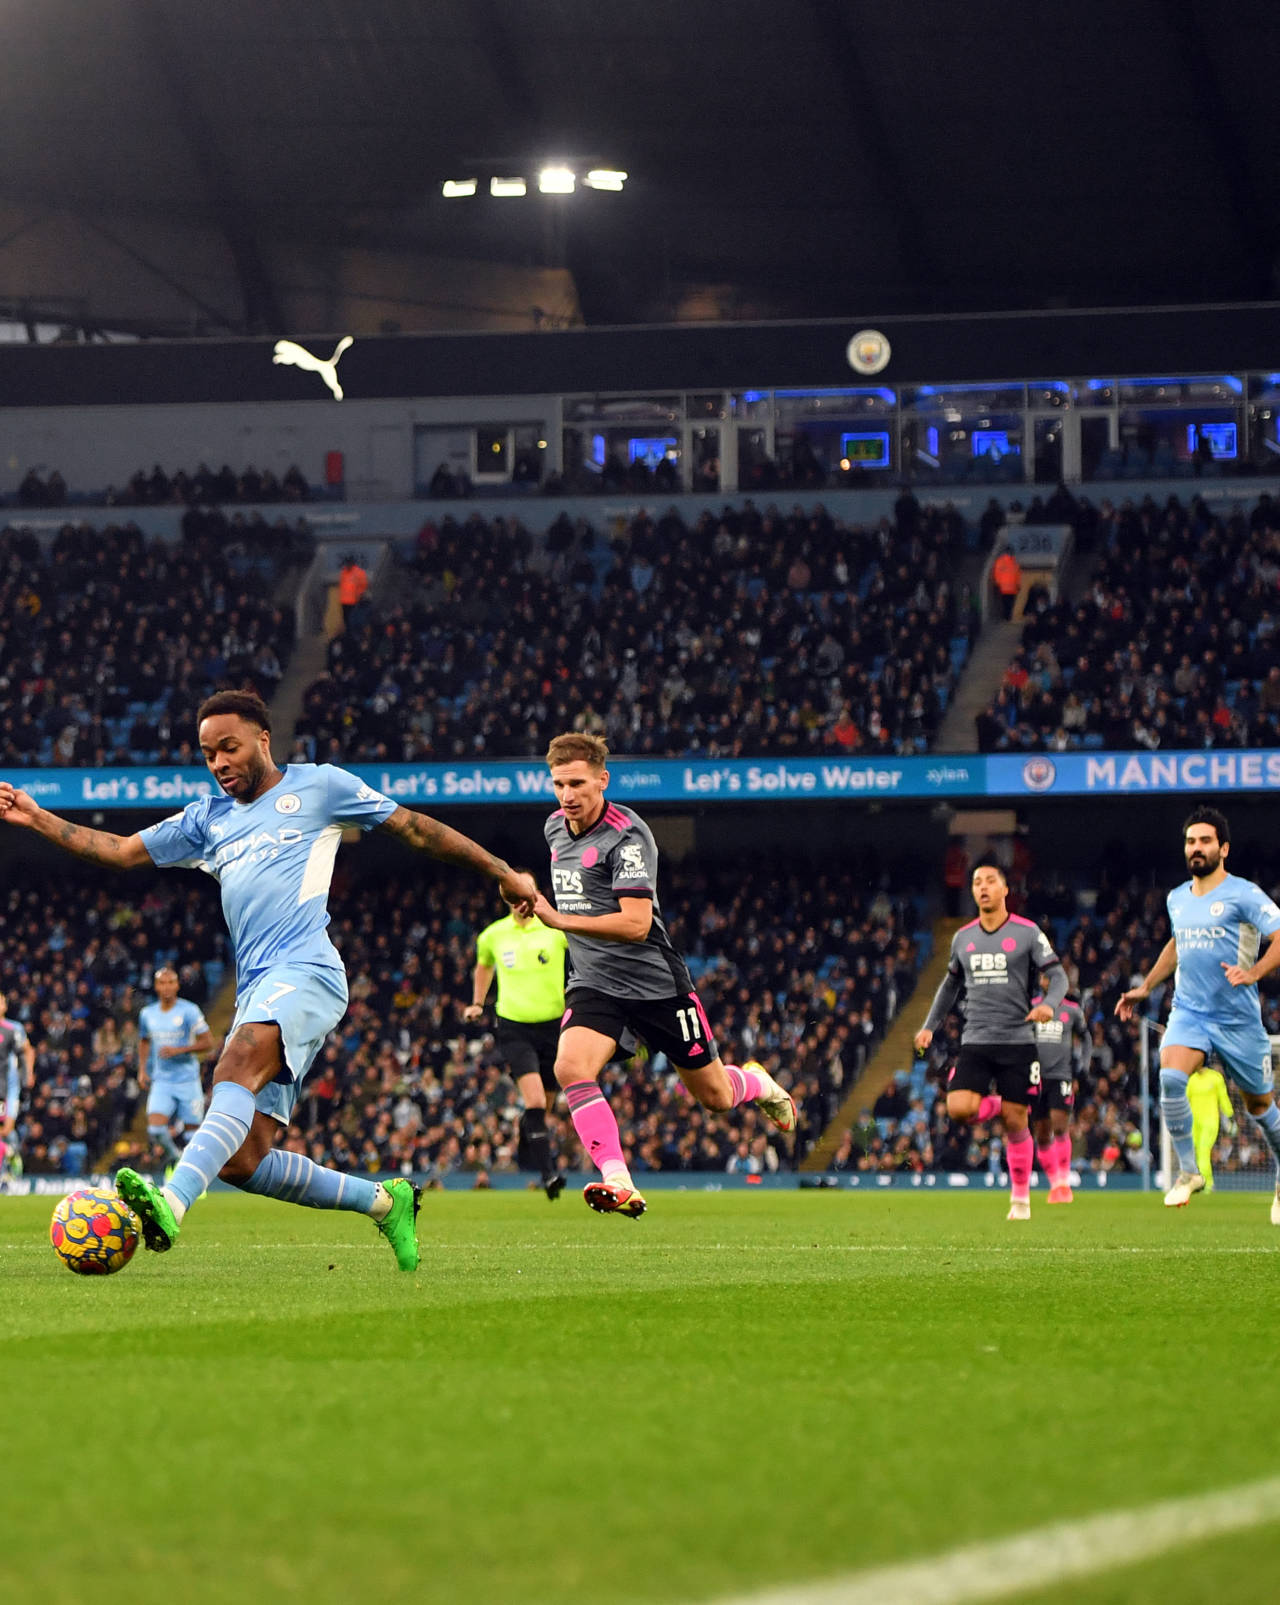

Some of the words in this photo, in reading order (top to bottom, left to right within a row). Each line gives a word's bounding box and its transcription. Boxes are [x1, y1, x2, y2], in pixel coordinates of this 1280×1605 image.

[82, 776, 139, 800] Let's
[144, 774, 212, 798] Solve
[381, 772, 437, 796] Let's
[443, 770, 511, 796] Solve
[683, 767, 741, 792] Let's
[747, 765, 816, 791] Solve
[822, 765, 903, 789] Water
[553, 868, 584, 894] FBS
[618, 871, 649, 879] SAIGON
[1175, 926, 1226, 940] TIHAD
[970, 953, 1007, 971] FBS
[264, 981, 297, 1004] 7
[676, 1007, 701, 1041] 11
[1030, 1061, 1041, 1085] 8
